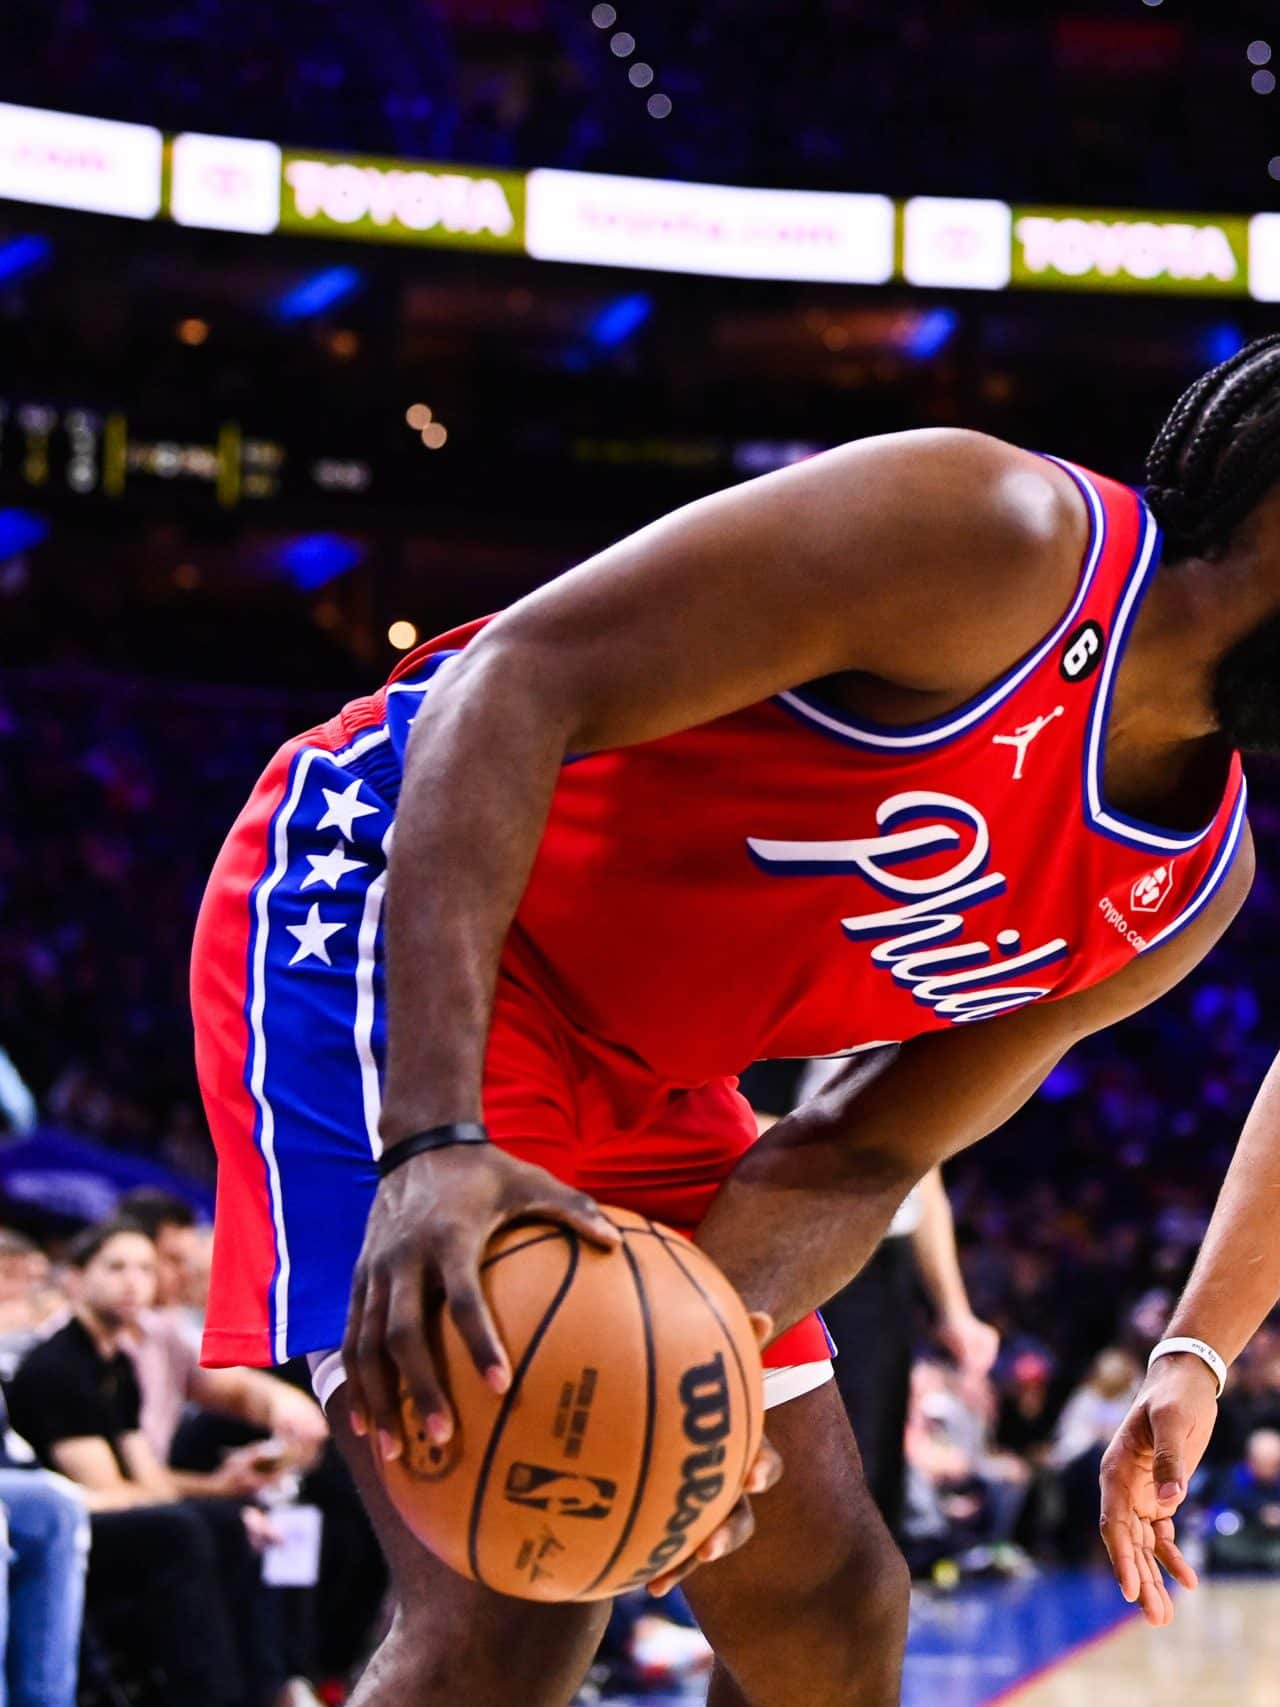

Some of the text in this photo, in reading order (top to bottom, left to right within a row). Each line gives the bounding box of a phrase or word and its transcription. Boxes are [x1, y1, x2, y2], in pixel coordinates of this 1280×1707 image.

[285, 159, 515, 237] TOYOTA
[1014, 216, 1238, 283] TOYOTA
[1063, 628, 1099, 676] 6
